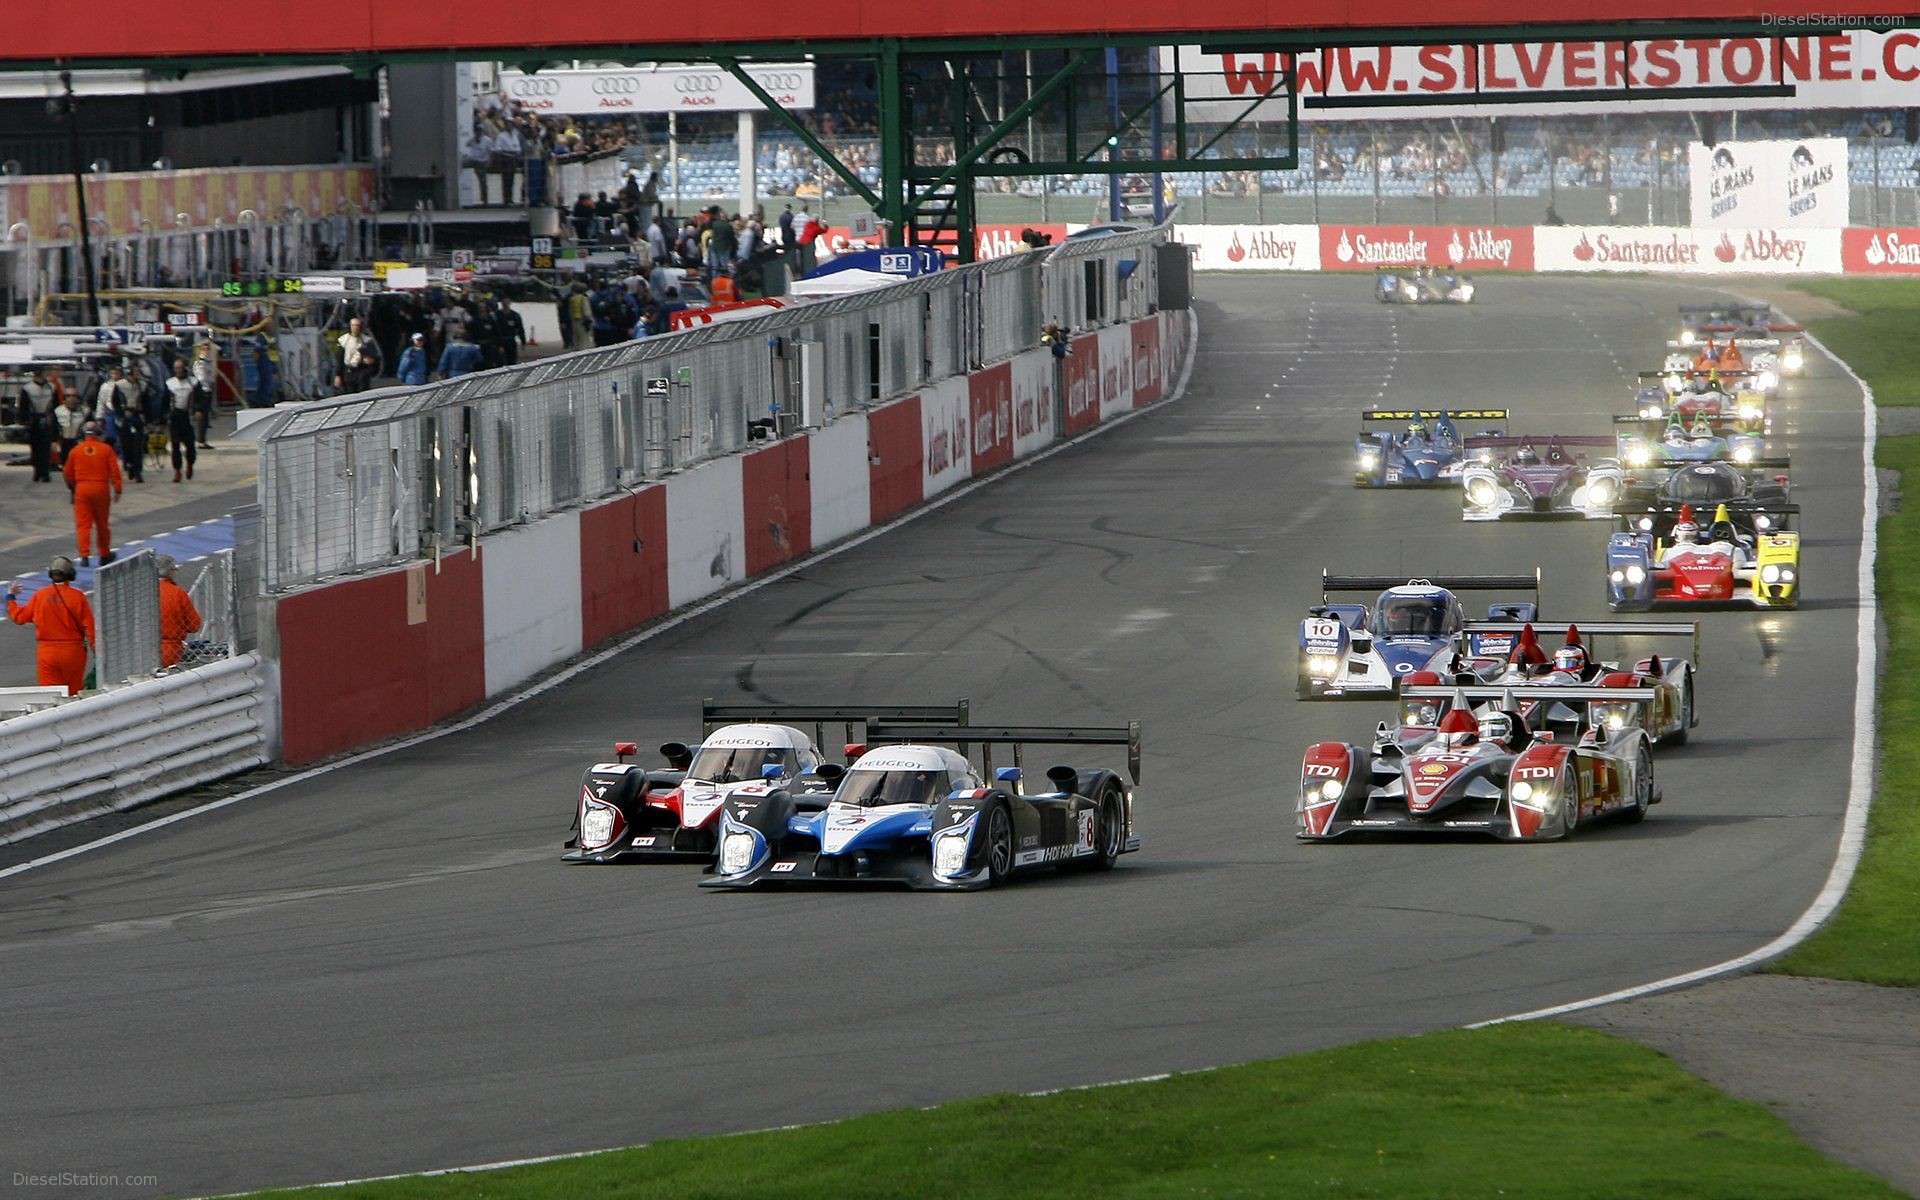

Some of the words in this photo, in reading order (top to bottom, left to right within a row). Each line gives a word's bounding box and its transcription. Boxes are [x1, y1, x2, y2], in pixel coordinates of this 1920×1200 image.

[599, 97, 634, 108] Audi
[682, 95, 716, 106] Audi
[1249, 230, 1297, 266] Abbey
[1356, 231, 1428, 264] Santander
[1467, 230, 1513, 266] Abbey
[1597, 233, 1701, 265] Santander
[1741, 230, 1807, 268] Abbey
[1311, 624, 1333, 636] 10
[709, 738, 774, 748] PEUGEOT
[857, 759, 925, 769] PEUGEOT
[1416, 753, 1471, 764] TDI
[1306, 764, 1341, 778] TDI
[1517, 766, 1555, 779] TDI
[1086, 816, 1094, 847] 8
[776, 863, 792, 871] P1
